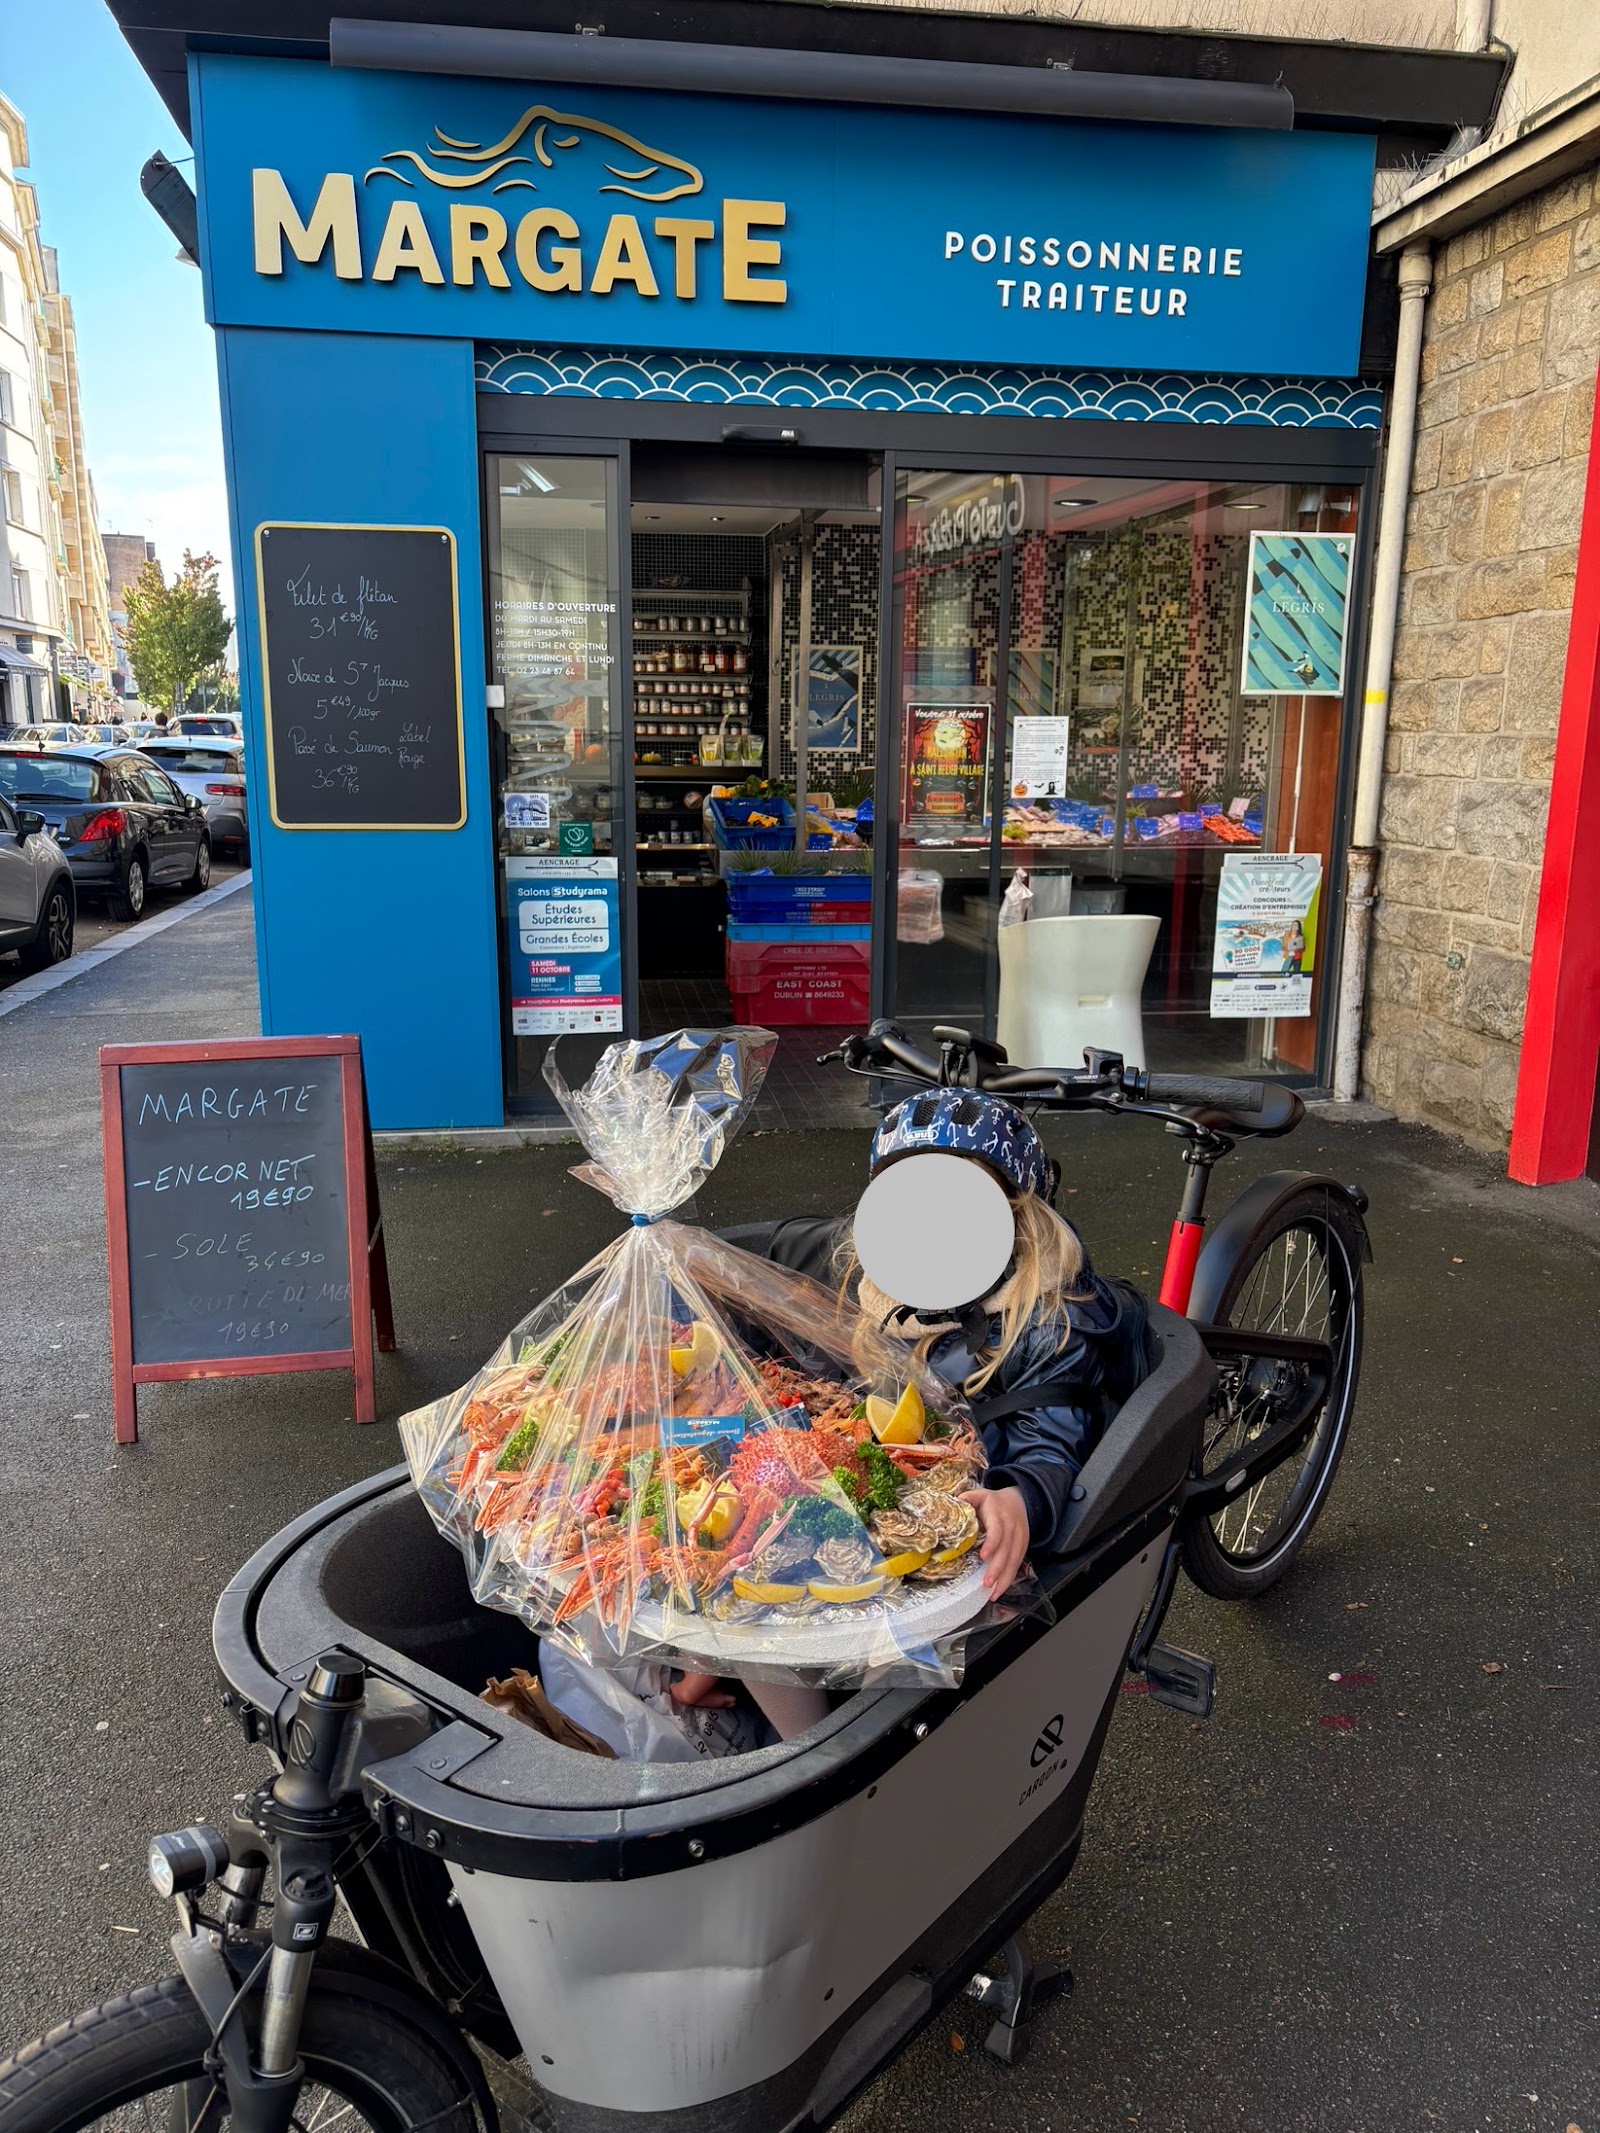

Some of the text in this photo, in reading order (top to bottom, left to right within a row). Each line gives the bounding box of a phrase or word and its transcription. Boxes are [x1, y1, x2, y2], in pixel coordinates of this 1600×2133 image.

[252, 167, 788, 305] MARGATE
[945, 230, 1243, 276] POISSONNERIE
[997, 279, 1188, 316] TRAITEUR
[332, 584, 348, 604] de
[357, 576, 398, 614] flétan
[495, 601, 616, 613] HORAIRES D'OUVERTURE
[1272, 601, 1325, 613] LEGRIS
[495, 614, 587, 625] DU MARDI AU SAMEDI
[533, 628, 575, 637] 15H30-19H
[496, 641, 521, 649] JEUDI
[554, 642, 566, 650] EN
[568, 642, 608, 651] CONTINU
[527, 654, 573, 663] DIMANCHE
[576, 655, 587, 663] ET
[588, 656, 615, 664] LUNDI
[324, 667, 337, 684] de
[367, 664, 410, 702] Jacques
[399, 721, 431, 744] Label
[324, 734, 339, 754] de
[343, 730, 393, 755] Saumon
[397, 746, 425, 769] Rouge
[517, 886, 608, 898] Salons Studyrama
[545, 902, 583, 915] Études
[532, 914, 597, 926] Supérieures
[526, 932, 604, 944] Grandes Écoles
[531, 960, 557, 968] SAMEDI
[540, 966, 571, 974] OCTOBRE
[530, 976, 557, 984] RENNES
[776, 980, 842, 989] EAST COAST
[774, 991, 803, 999] DUBLIN
[138, 1085, 318, 1126] MARGATE
[230, 1186, 314, 1211] 19€90
[173, 1232, 253, 1260] SOLE
[217, 1320, 289, 1344] 19€90
